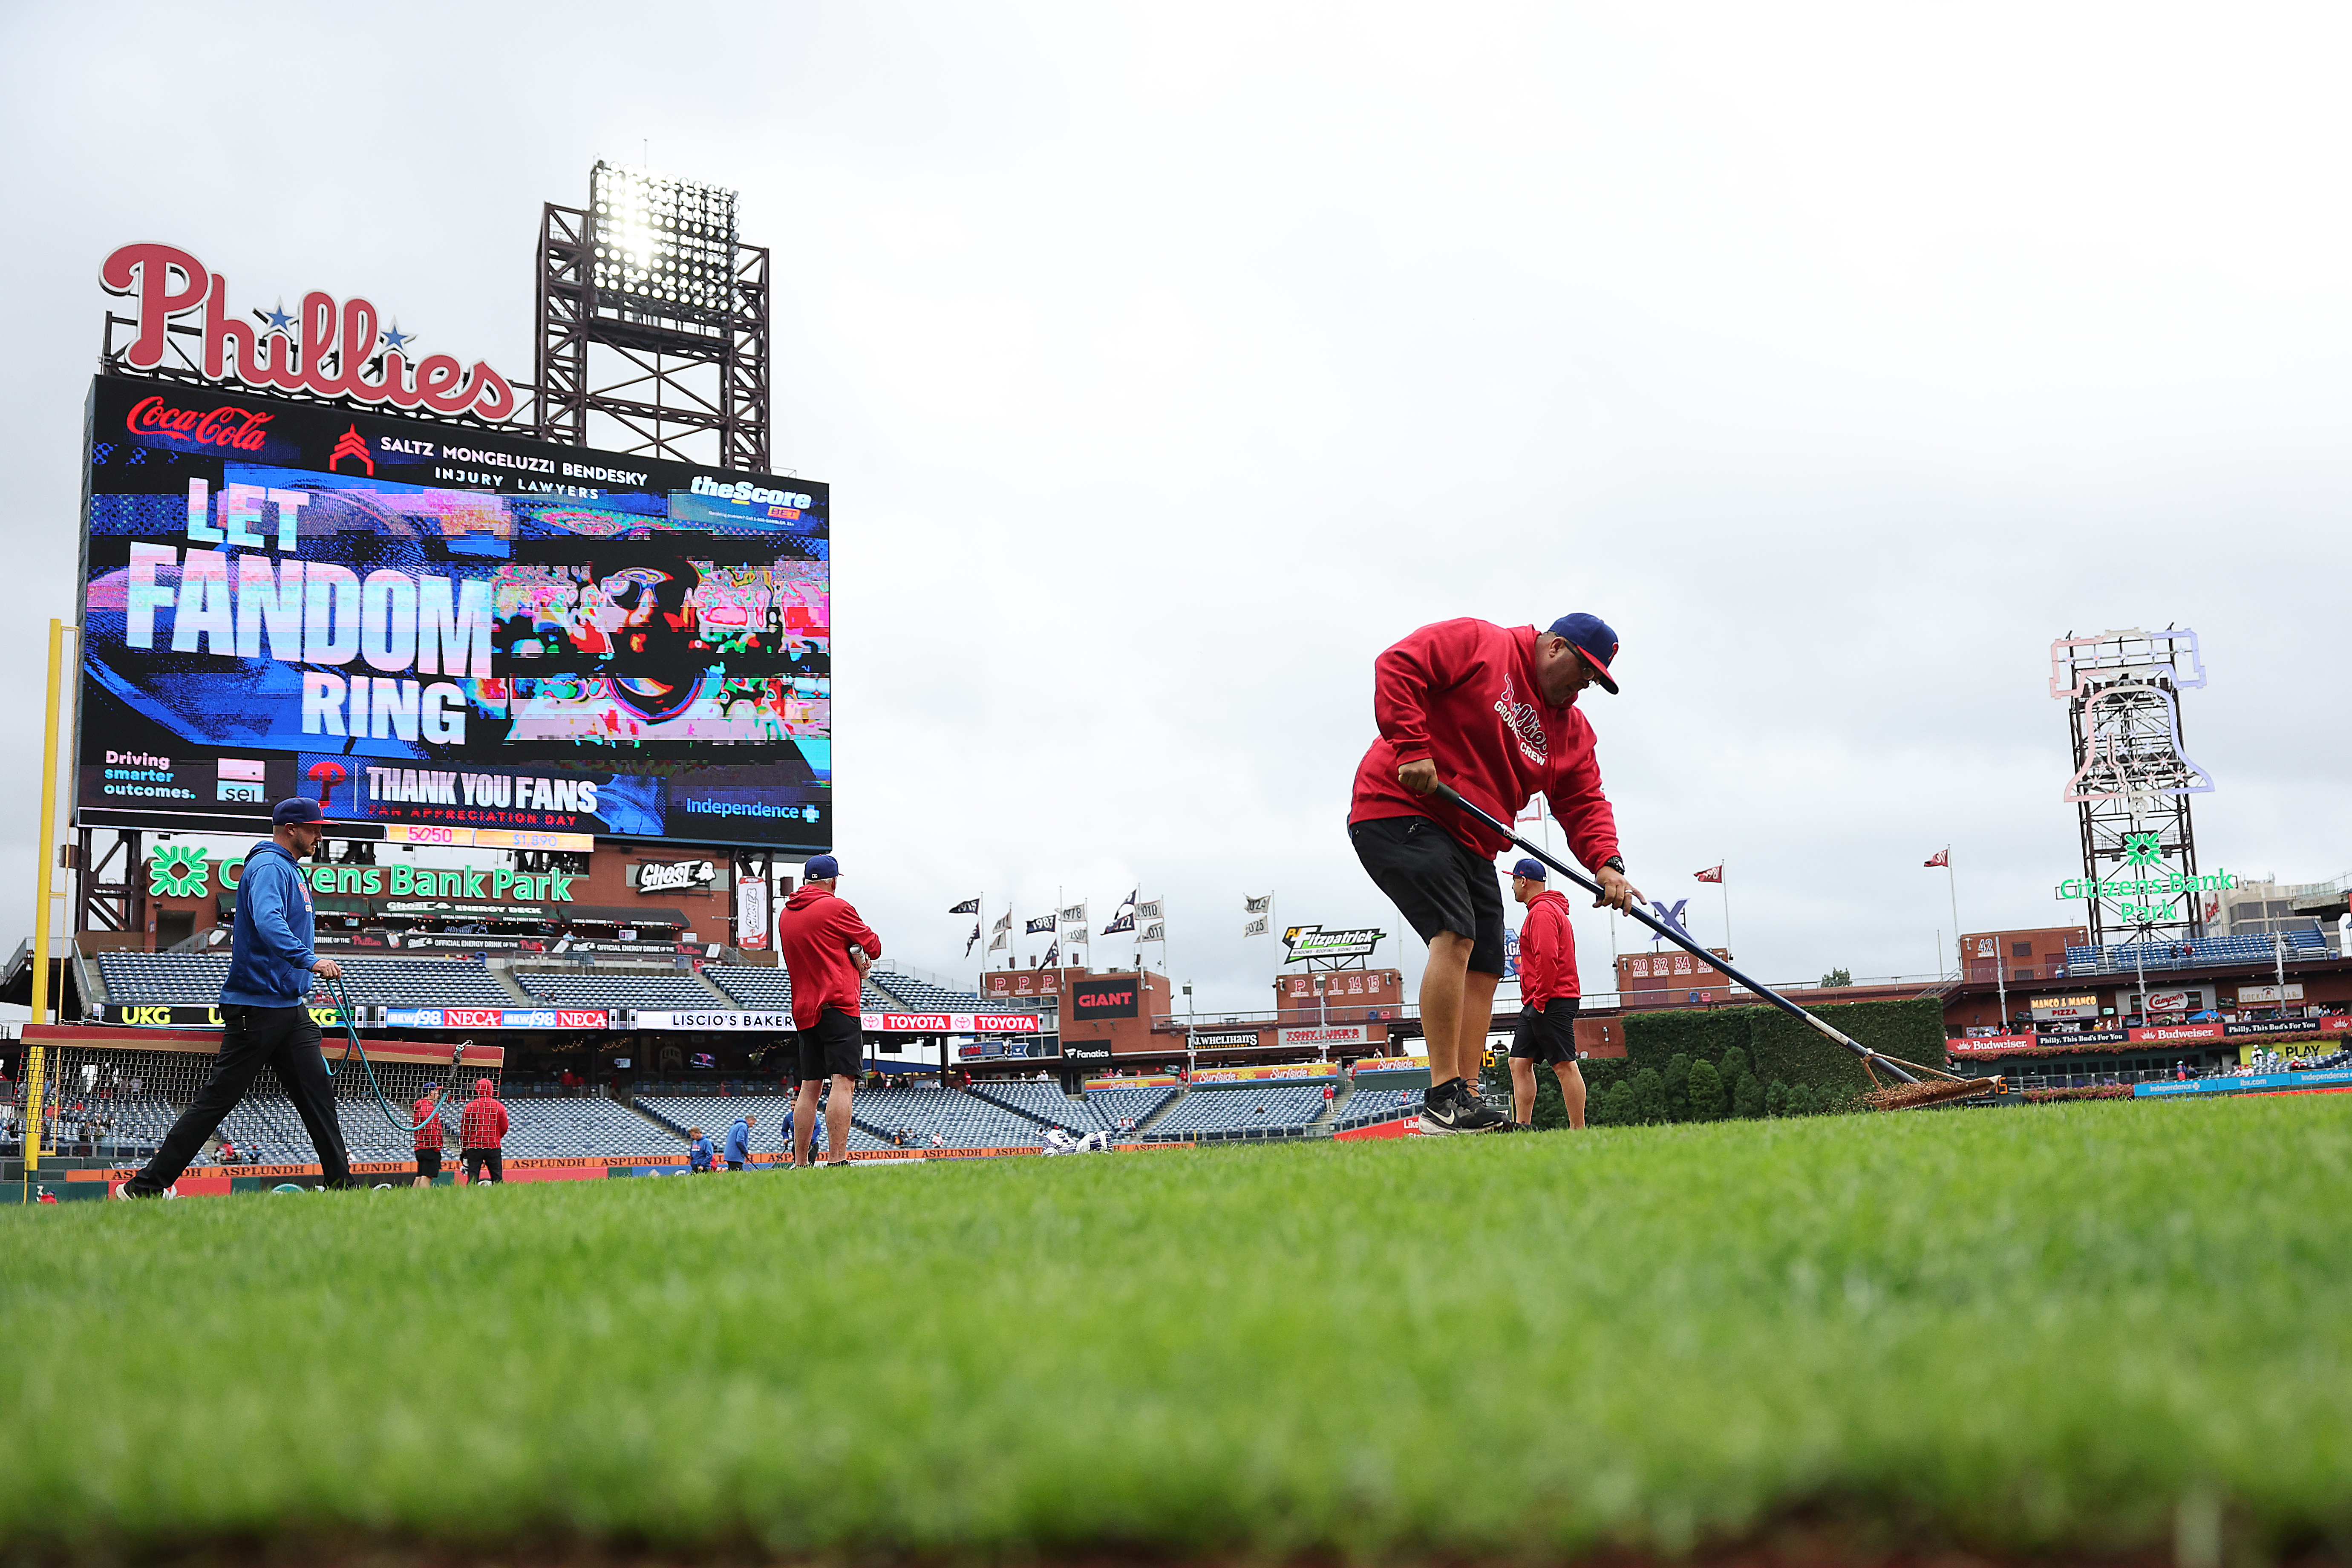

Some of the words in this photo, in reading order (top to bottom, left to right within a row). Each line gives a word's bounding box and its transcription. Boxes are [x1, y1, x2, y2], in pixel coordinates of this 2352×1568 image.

[98, 240, 515, 423] Phillies
[127, 396, 275, 451] Coca-Cola
[380, 436, 434, 457] SALTZ
[442, 444, 555, 474] MONGELUZZI
[562, 461, 649, 487] BENDESKY
[435, 467, 504, 487] INJURY
[517, 478, 599, 500] LAWYERS
[690, 476, 812, 509] theScore
[187, 476, 310, 552] LET
[772, 508, 797, 517] BET
[126, 541, 493, 680] FANDOM
[300, 671, 467, 746] RING
[105, 750, 170, 770] Driving
[1519, 741, 1545, 766] CREW
[104, 769, 174, 783] smarter
[104, 784, 196, 799] outcomes.
[366, 766, 457, 805] THANK
[460, 772, 511, 808] YOU
[515, 776, 598, 813] FANS
[686, 798, 799, 819] Independence
[368, 804, 402, 816] FAN
[411, 807, 537, 823] APPRECIATION
[545, 814, 577, 827] DAY
[513, 834, 557, 846] $1,890
[389, 864, 487, 899] Bank
[492, 866, 574, 902] Park
[639, 860, 701, 893] GHOST
[2061, 877, 2163, 899] Citizens
[2169, 868, 2234, 892] Bank
[386, 901, 435, 911] GHOST
[454, 905, 507, 913] ENERGY
[746, 894, 759, 929] GHOST
[2121, 899, 2177, 922] Park
[351, 934, 382, 946] Phillies
[1285, 928, 1303, 939] PJ
[1290, 926, 1375, 948] Fitzpatrick
[407, 937, 427, 949] GHOST
[572, 942, 591, 951] GHOST
[675, 944, 702, 954] Phillies
[1978, 938, 1994, 952] 42
[1633, 958, 1648, 972] 20
[1653, 957, 1668, 971] 32
[1675, 956, 1691, 971] 34
[995, 978, 1006, 991] P
[1018, 976, 1029, 989] P
[1043, 974, 1054, 988] P
[1294, 979, 1306, 992] P
[1332, 977, 1339, 990] 1
[1348, 976, 1362, 989] 14
[1367, 975, 1380, 988] 15
[1078, 992, 1133, 1007] GIANT
[2031, 998, 2059, 1008] MANCO
[2061, 997, 2067, 1007] &
[2068, 995, 2097, 1006] MANCO
[2242, 993, 2276, 1001] COCKTAIL
[121, 1006, 171, 1024] UKG
[387, 1013, 415, 1023] IBEW
[419, 1010, 441, 1025] 98
[447, 1011, 501, 1026] NECA
[504, 1014, 531, 1023] IBEW
[534, 1011, 555, 1026] 98
[560, 1012, 606, 1027] NECA
[673, 1015, 737, 1026] LISCIO'S
[888, 1016, 947, 1029] TOYOTA
[979, 1017, 1035, 1030] TOYOTA
[1286, 1030, 1317, 1038] TONY
[1077, 1049, 1109, 1058] Fanatics
[2285, 1045, 2321, 1058] PLAY
[1377, 1059, 1413, 1071] Surfside
[1482, 1050, 1496, 1068] 15
[1199, 1071, 1237, 1084] Surfside
[1270, 1068, 1307, 1080] Surfside
[2301, 1071, 2348, 1081] Independence
[2150, 1084, 2192, 1092] Independence
[1404, 1119, 1419, 1128] Like
[847, 1151, 909, 1159] ASPLUNDH
[922, 1149, 982, 1158] ASPLUNDH
[513, 1158, 585, 1168] ASPLUNDH
[601, 1157, 672, 1167] ASPLUNDH
[220, 1166, 304, 1176] ASPLUNDH
